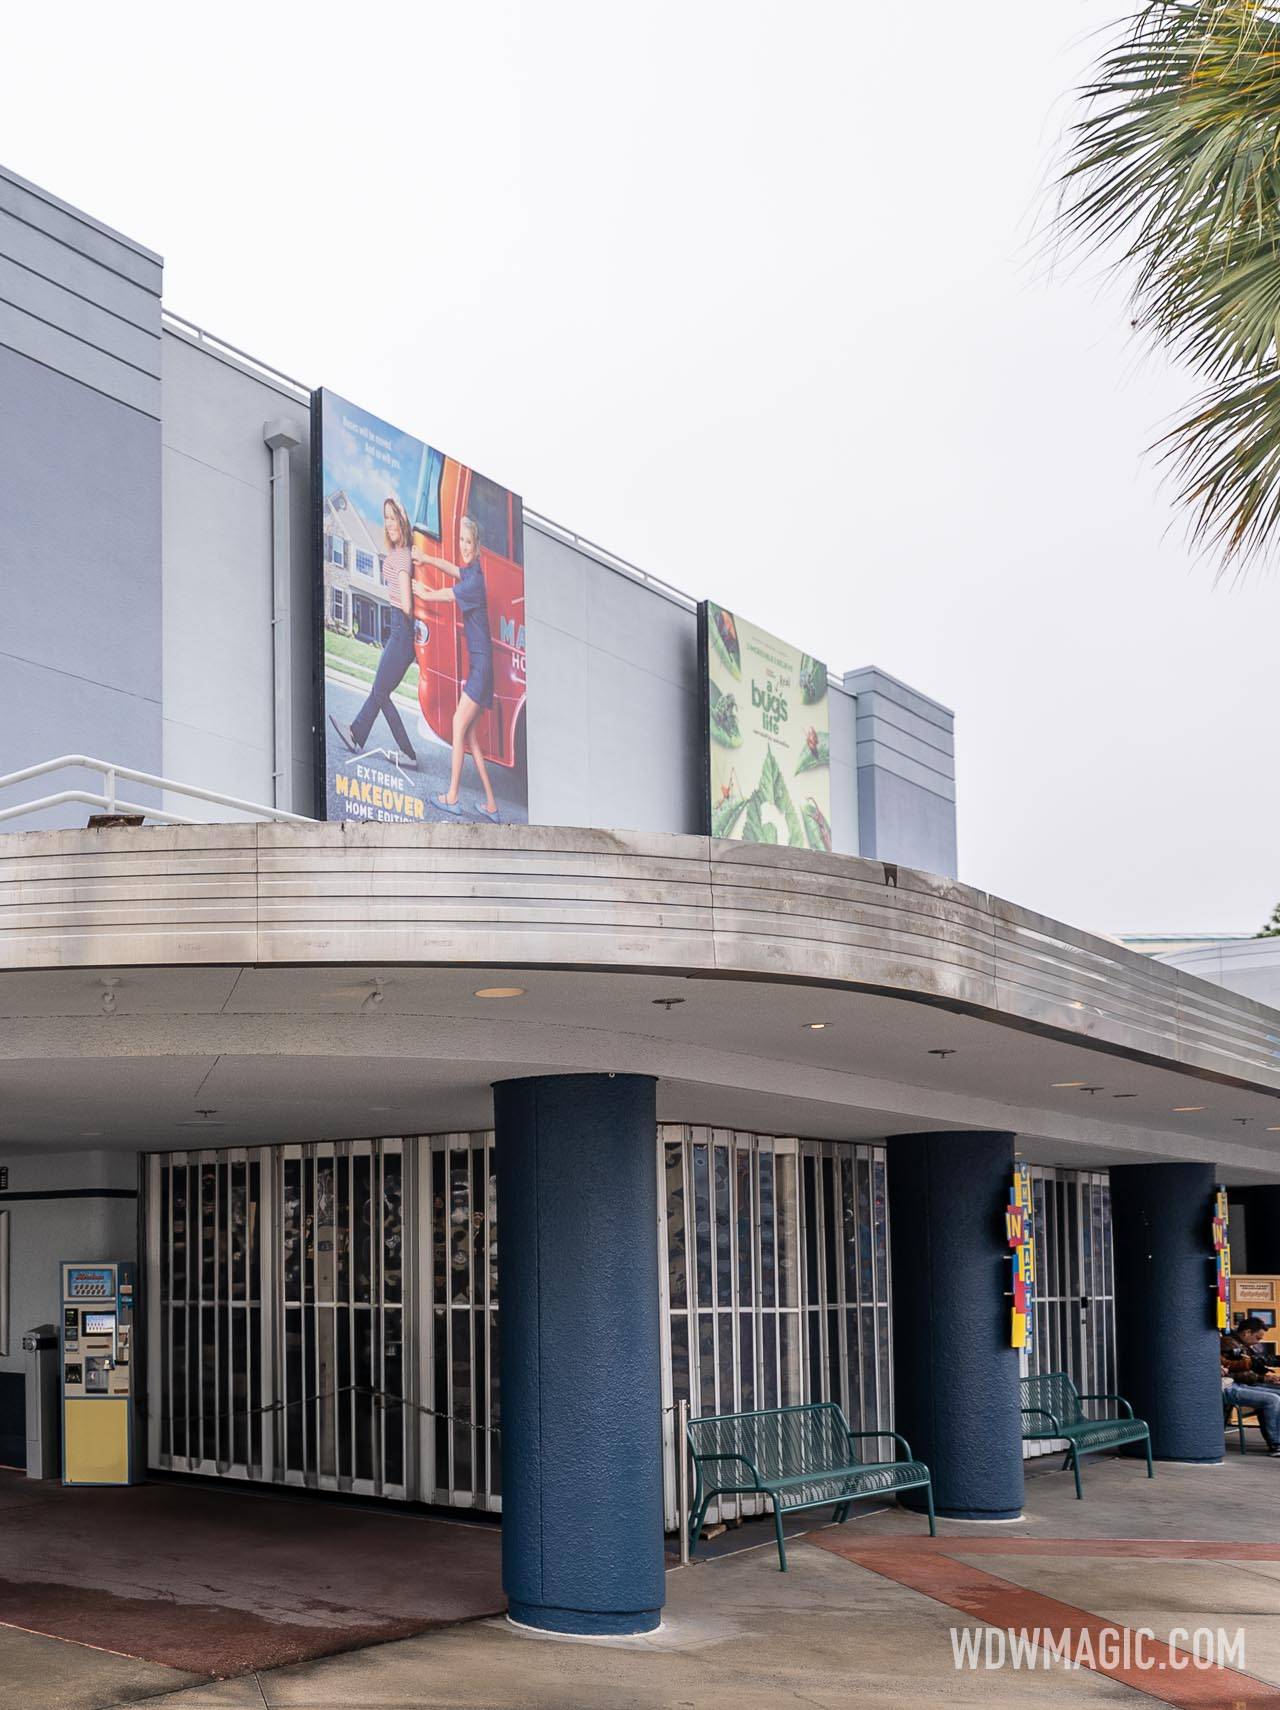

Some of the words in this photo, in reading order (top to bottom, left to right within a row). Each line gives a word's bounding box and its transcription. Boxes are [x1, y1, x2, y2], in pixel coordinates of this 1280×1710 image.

[766, 680, 773, 693] a
[752, 679, 788, 722] bug's
[762, 711, 779, 735] life
[357, 765, 404, 790] EXTREME
[335, 773, 425, 820] MAKEOVER
[345, 800, 374, 819] HOME
[1005, 1211, 1022, 1241] IN
